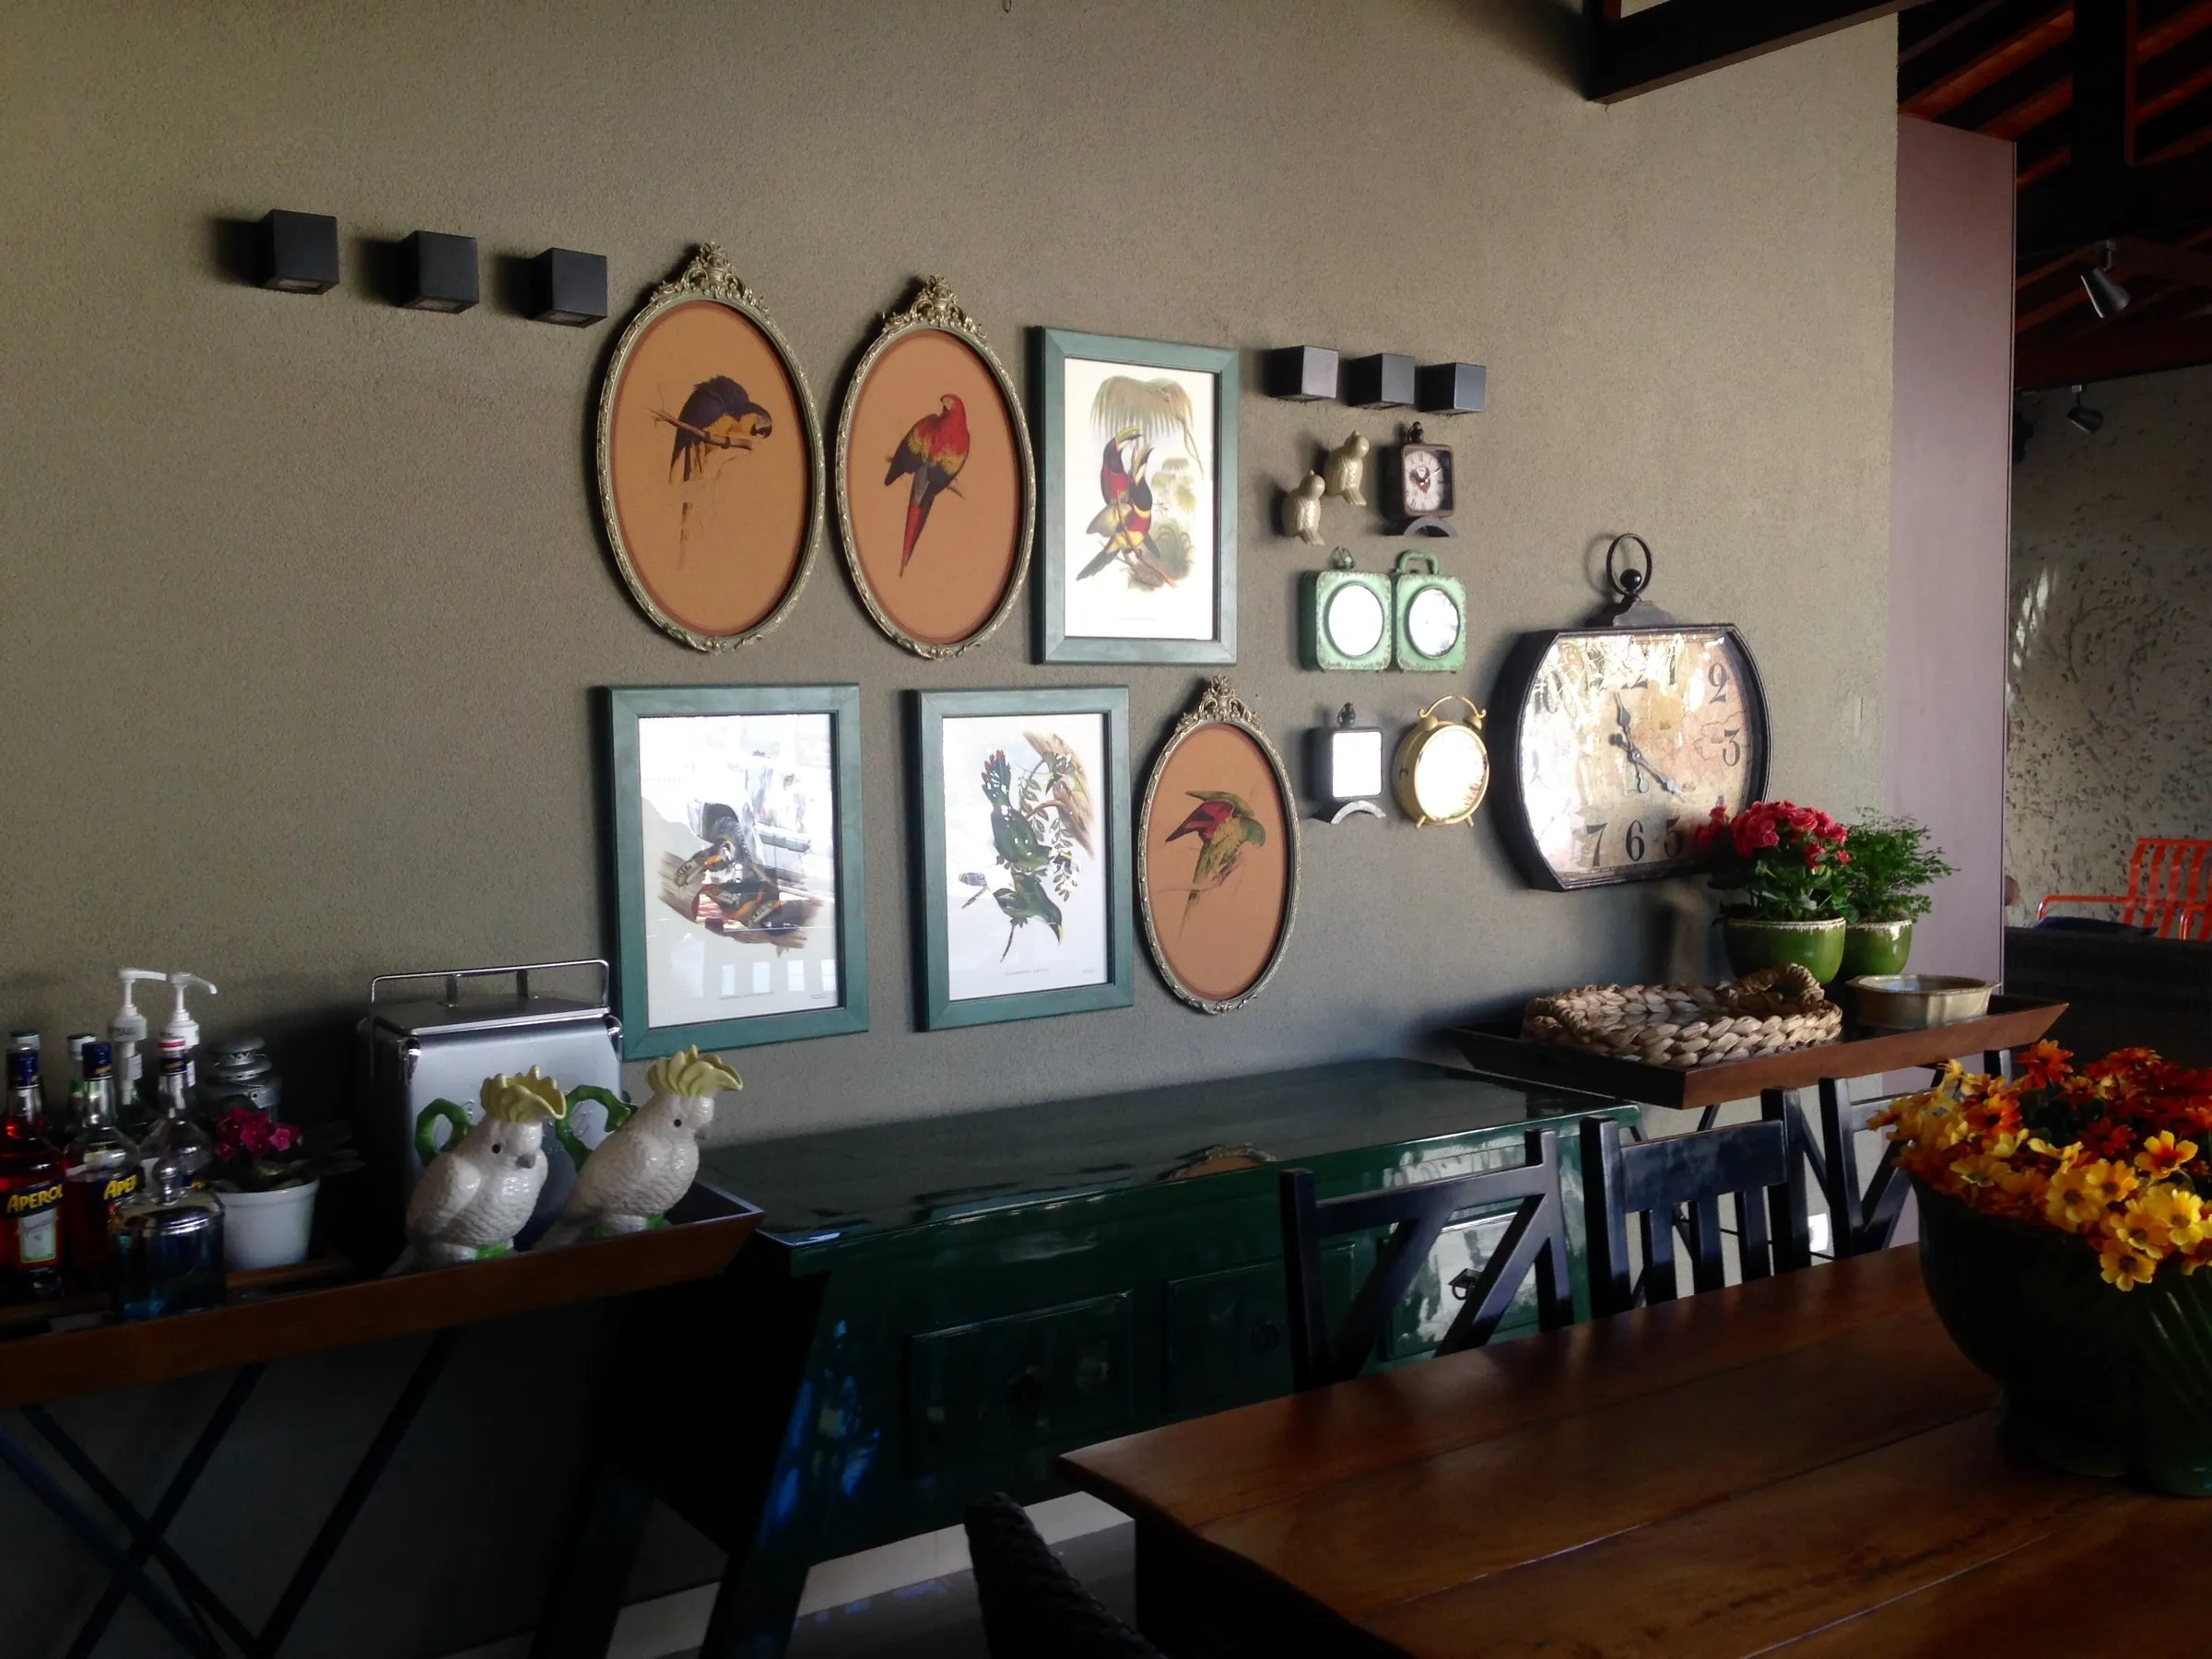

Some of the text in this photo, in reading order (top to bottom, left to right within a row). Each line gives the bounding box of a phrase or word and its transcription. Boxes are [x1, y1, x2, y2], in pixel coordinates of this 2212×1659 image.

[1708, 663, 1728, 703] 2
[1722, 728, 1741, 767] 3
[1586, 821, 1608, 867] 7
[1625, 819, 1645, 862] 6
[1664, 815, 1683, 858] 5
[6, 1183, 64, 1213] APEROL
